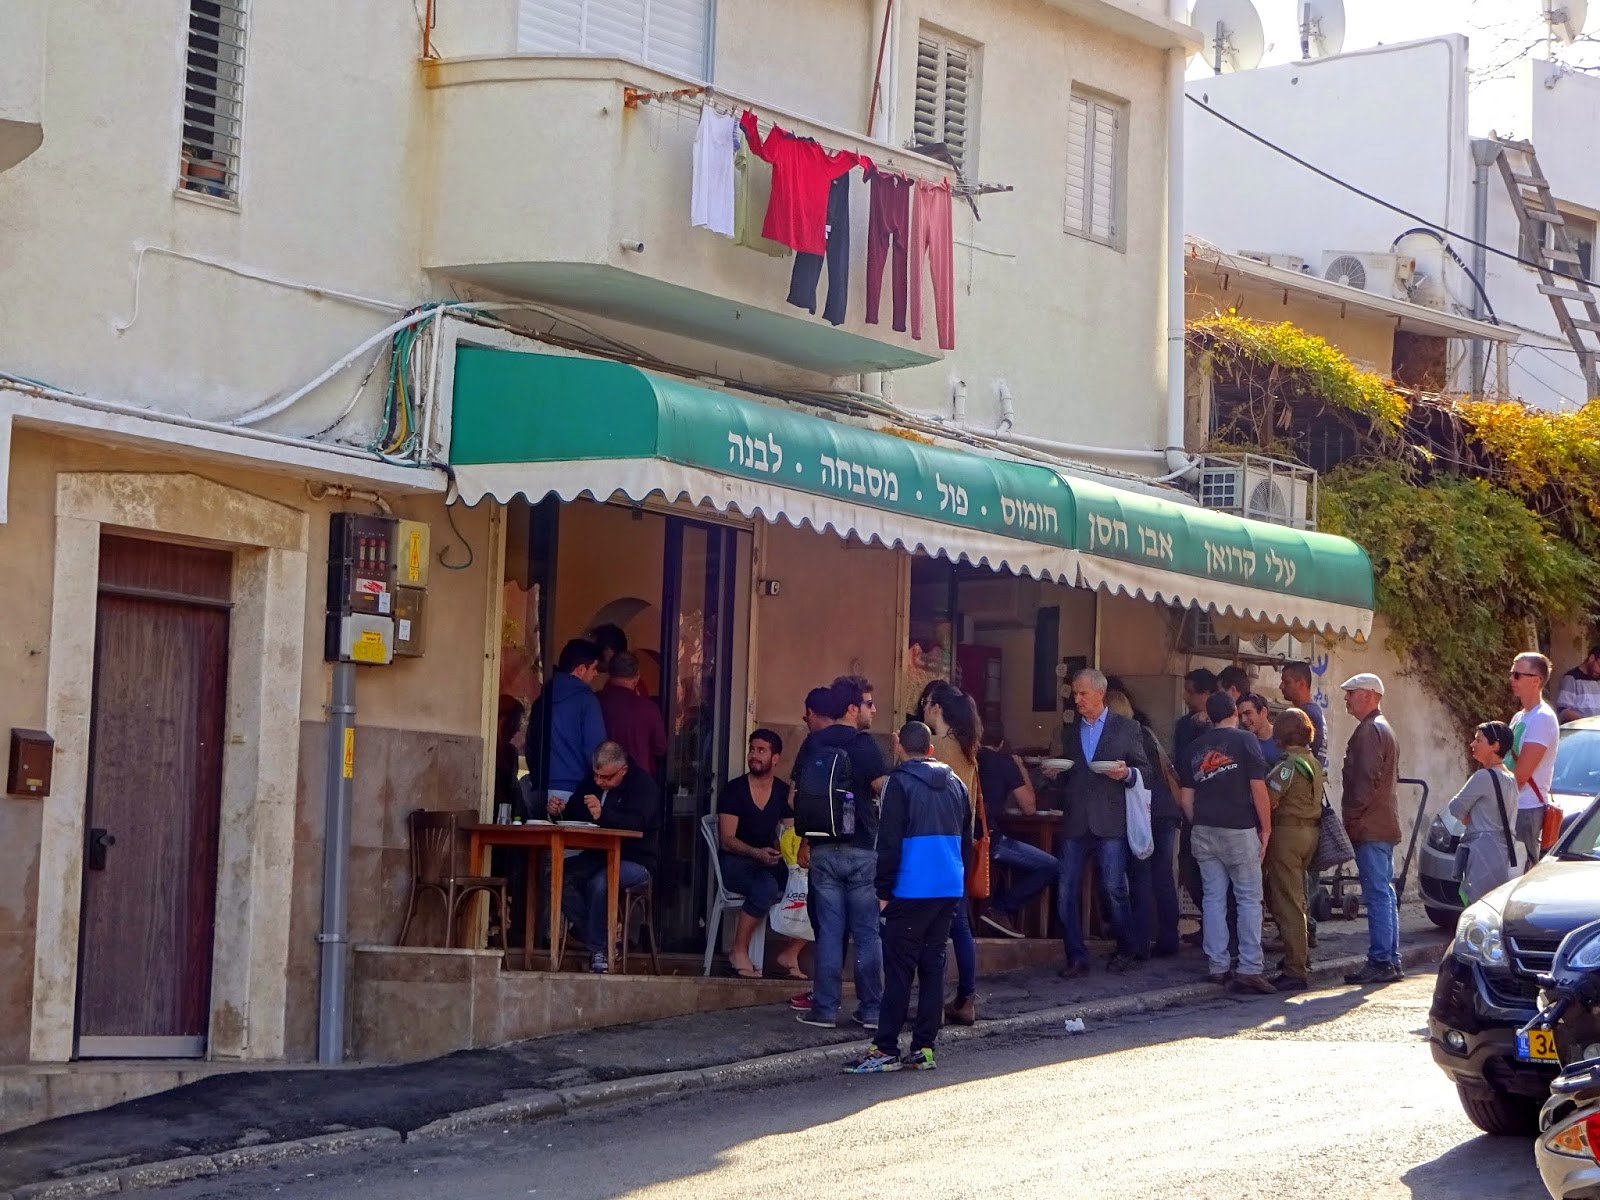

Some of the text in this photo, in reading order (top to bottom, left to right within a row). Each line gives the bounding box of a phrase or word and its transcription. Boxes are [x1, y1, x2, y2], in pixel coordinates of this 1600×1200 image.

[728, 430, 1058, 534] חומוס פול מסבחה לבנה
[1088, 511, 1296, 587] עלי קרואן אבו חסן
